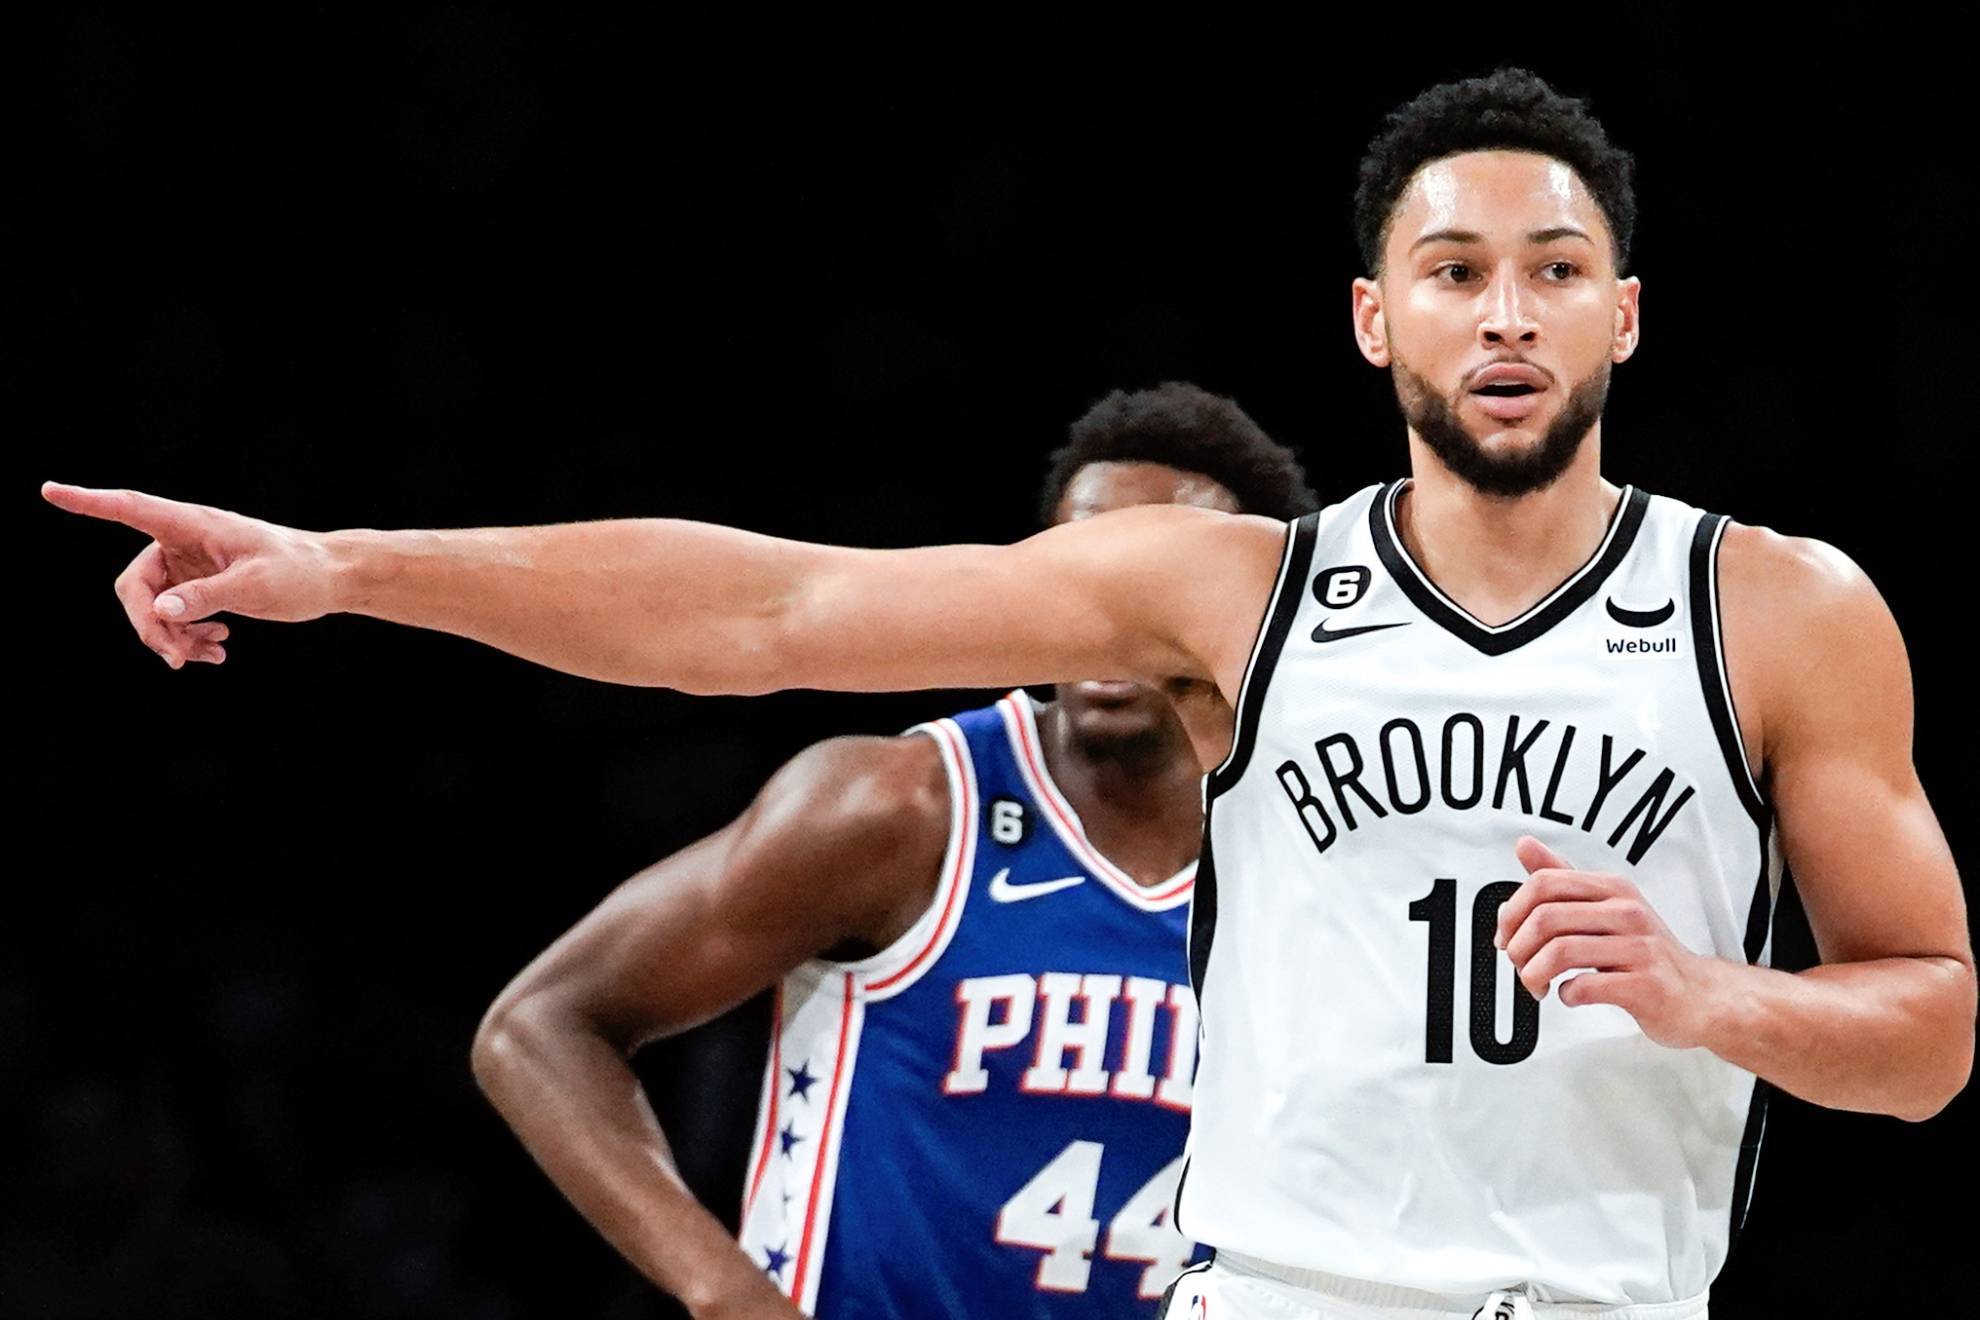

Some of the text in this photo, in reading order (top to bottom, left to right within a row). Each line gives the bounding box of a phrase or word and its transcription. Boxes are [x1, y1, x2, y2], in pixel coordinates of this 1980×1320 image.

[1325, 571, 1361, 604] 6
[1605, 637, 1677, 654] Webull
[991, 799, 1024, 845] 6
[1275, 712, 1696, 867] BROOKLYN
[1408, 878, 1540, 1066] 10
[993, 1138, 1197, 1300] 44
